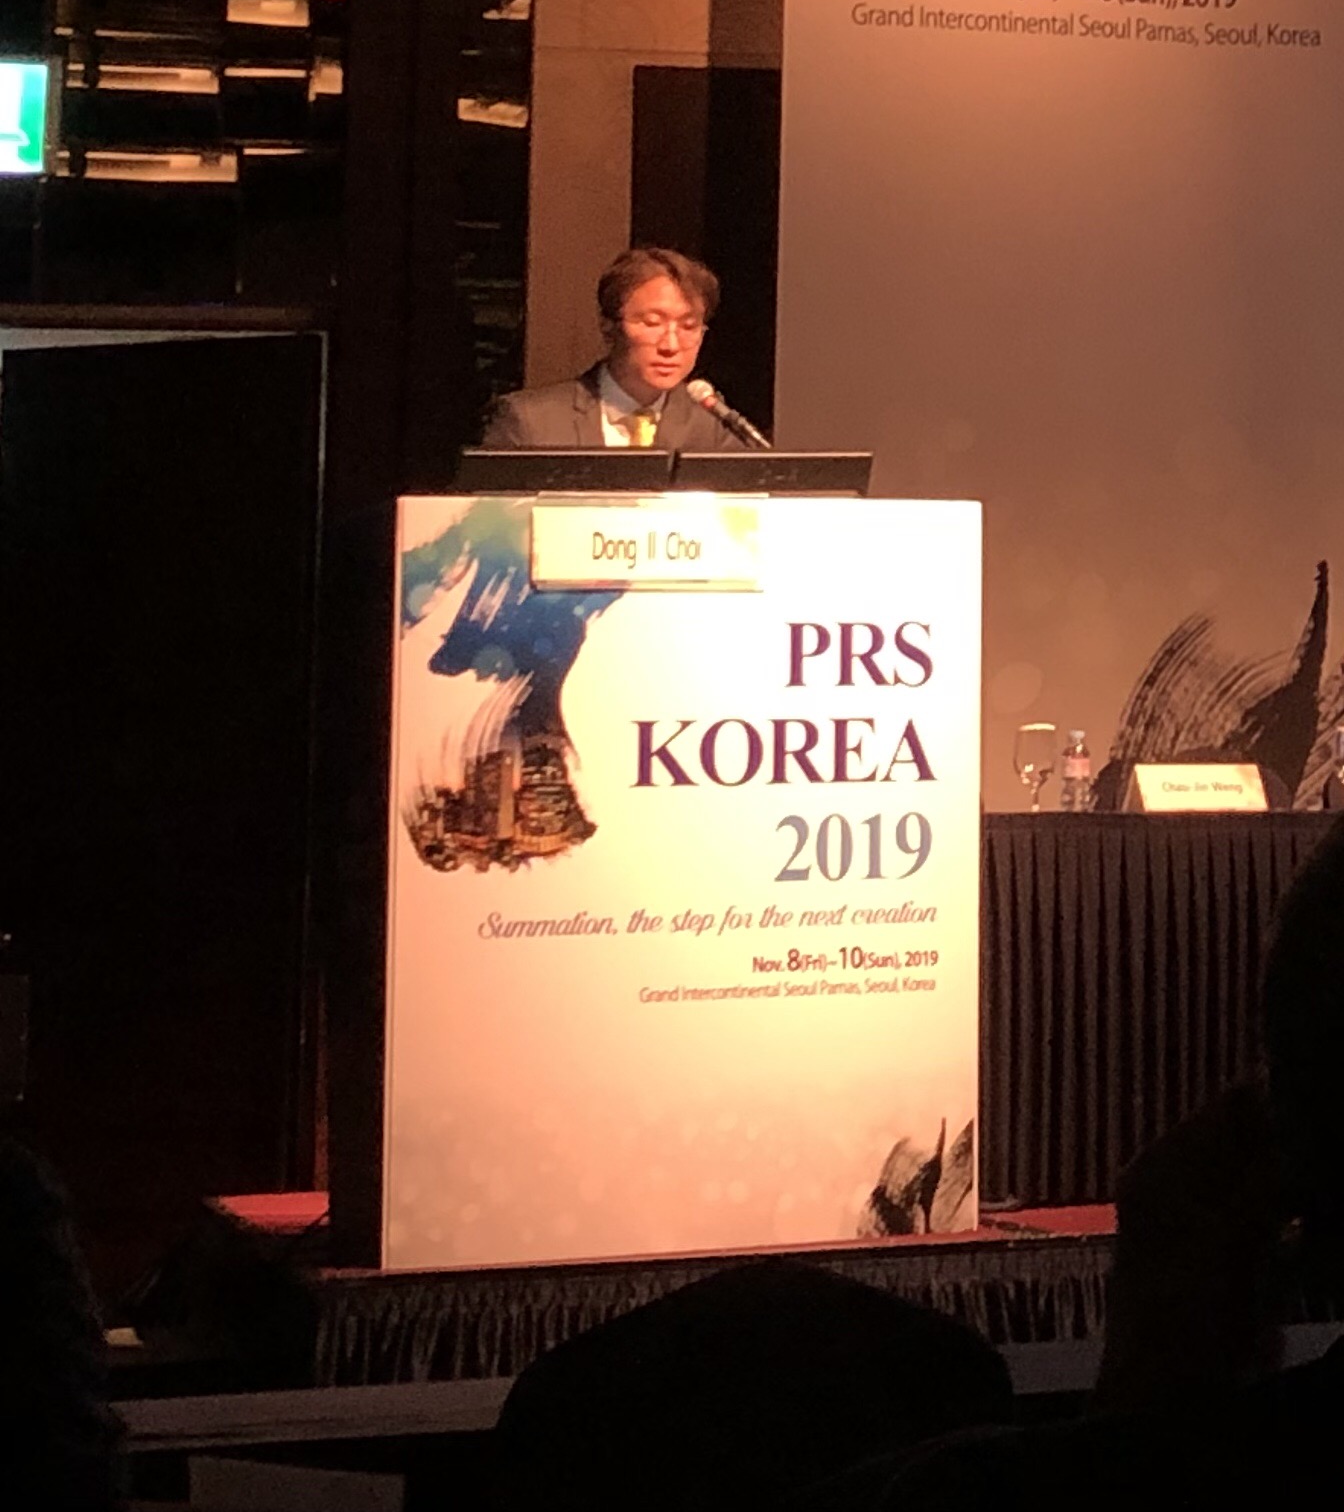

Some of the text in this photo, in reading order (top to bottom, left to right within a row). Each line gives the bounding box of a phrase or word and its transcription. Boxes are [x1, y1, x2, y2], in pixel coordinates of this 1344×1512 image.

[852, 2, 915, 29] Grand
[919, 5, 1074, 38] Intercontinental
[1078, 13, 1131, 40] Seoul
[1204, 23, 1263, 48] Seoul,
[1266, 24, 1321, 48] Korea
[592, 531, 637, 570] Dong
[784, 621, 933, 688] PRS
[629, 718, 938, 788] KOREA
[774, 812, 932, 882] 2019
[478, 901, 937, 940] Summation, the step for the next creation
[752, 956, 783, 974] Nov.
[904, 950, 939, 968] 2019
[639, 985, 678, 1003] Grand
[784, 979, 817, 997] Seoul
